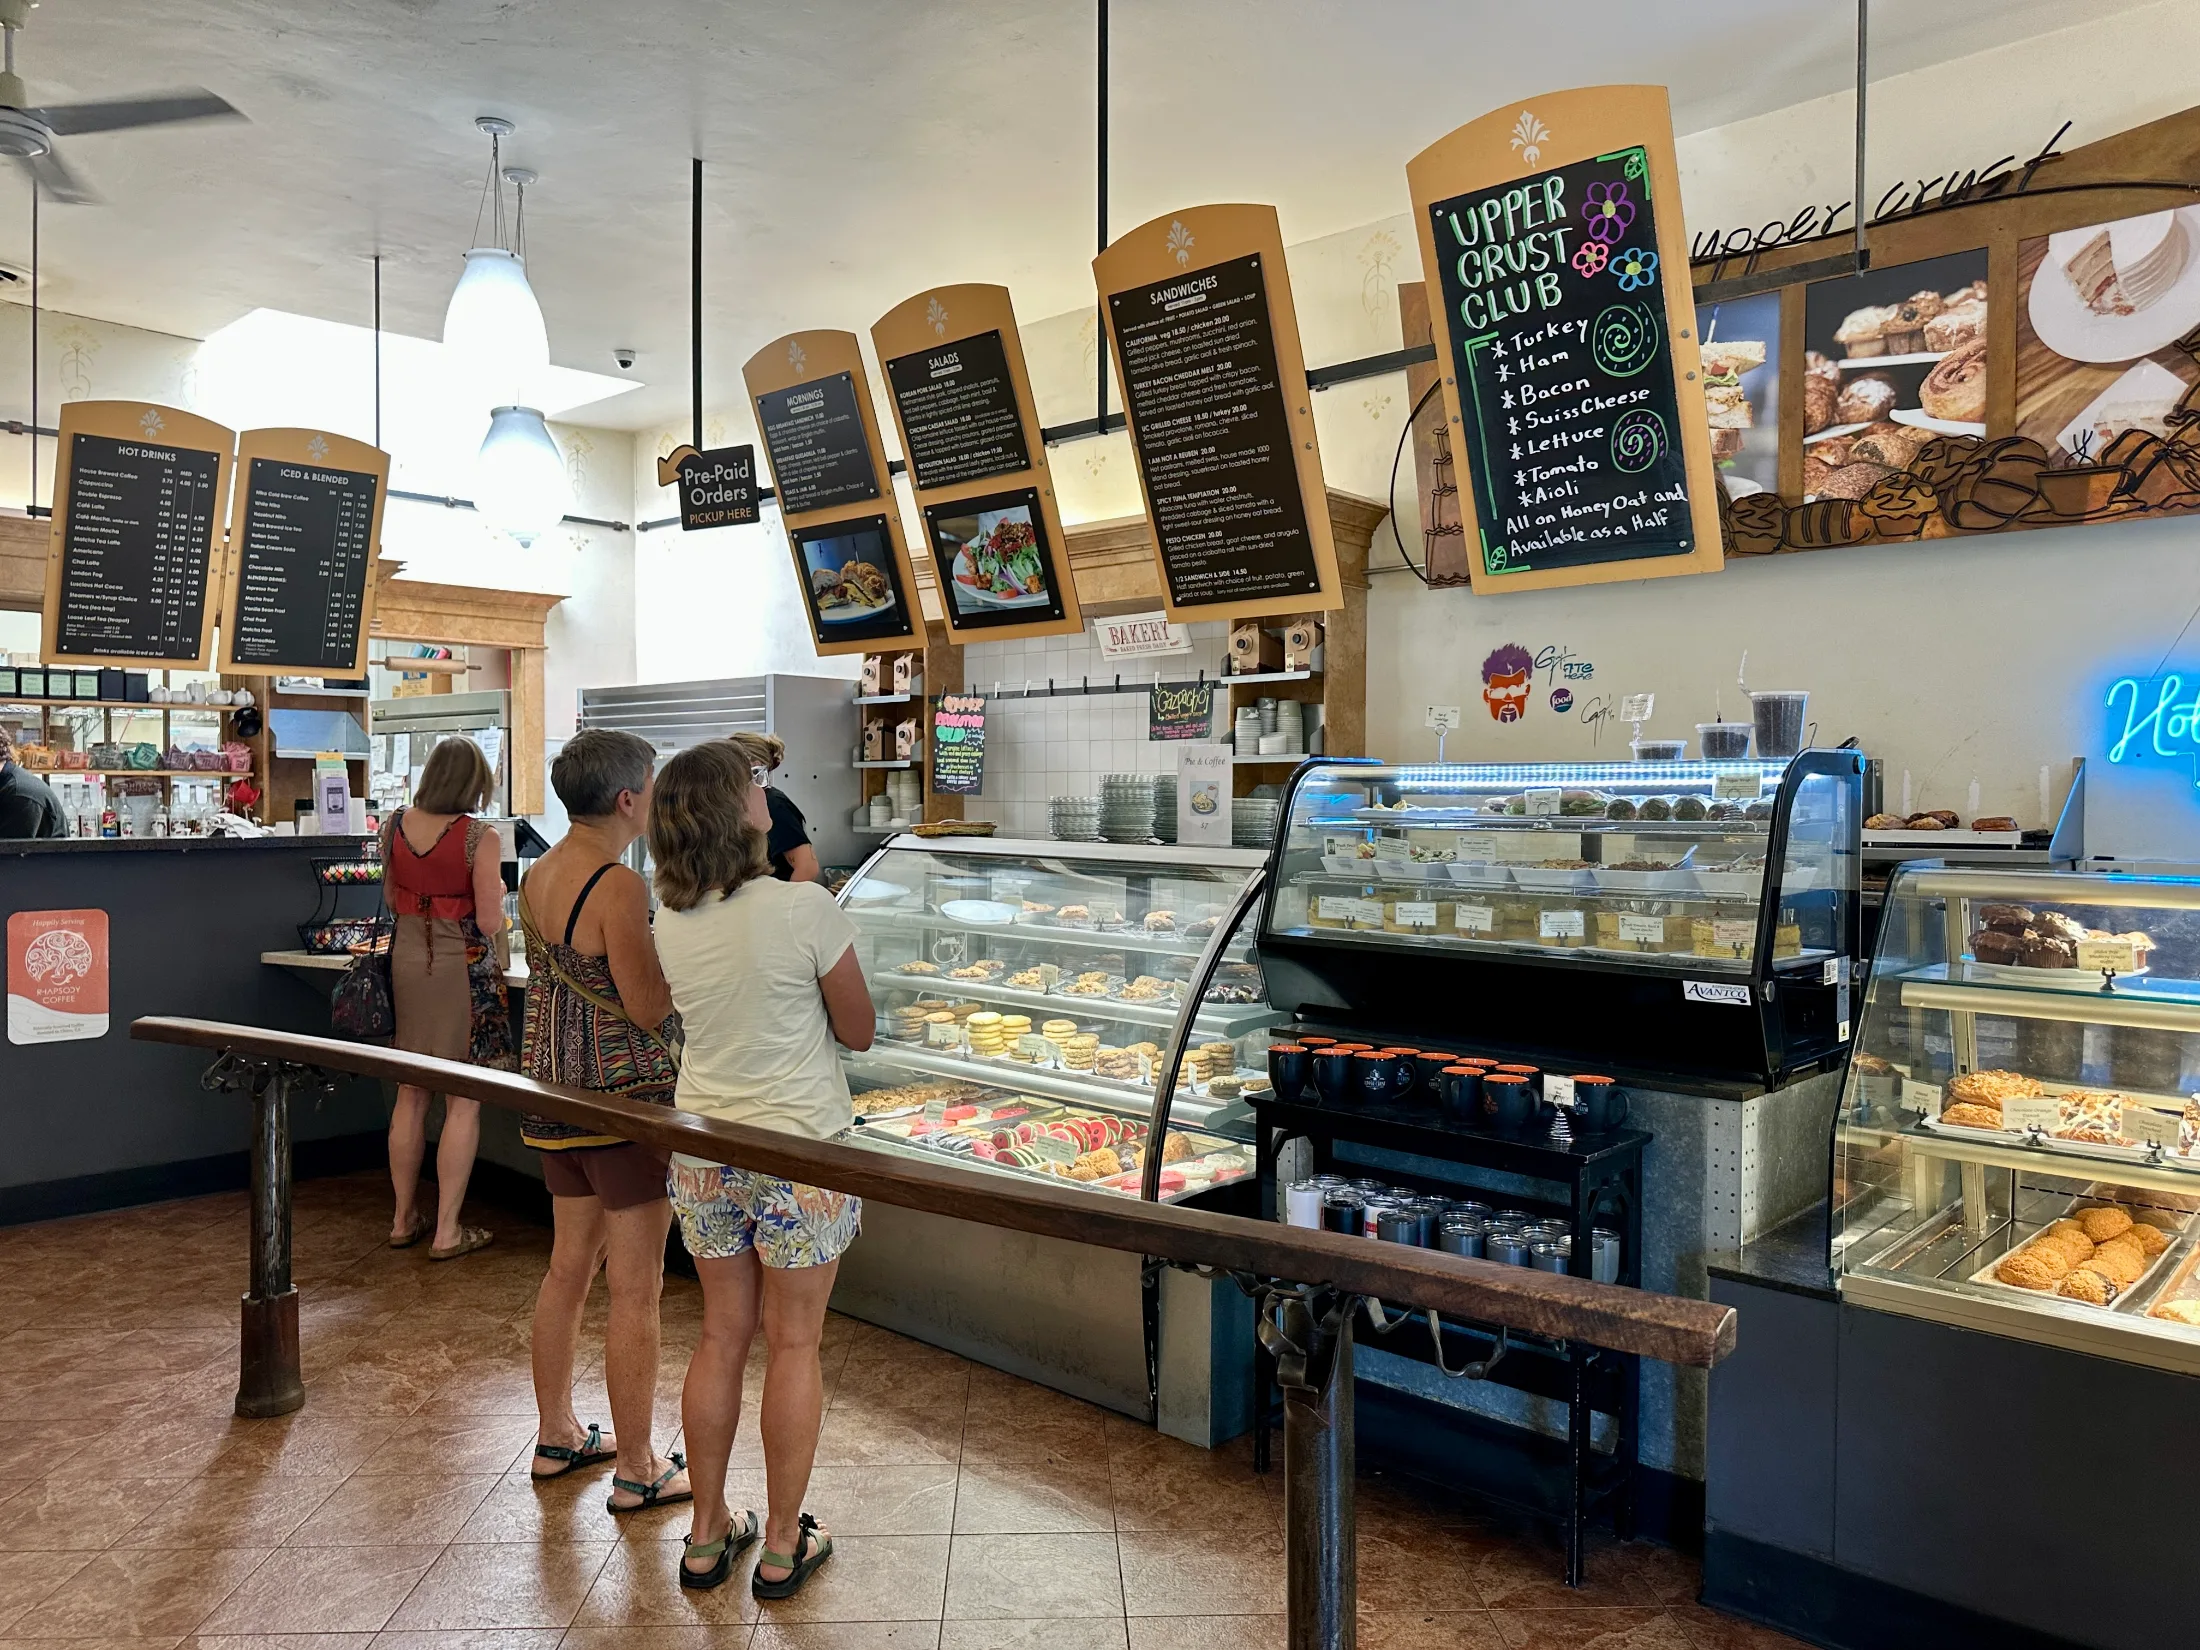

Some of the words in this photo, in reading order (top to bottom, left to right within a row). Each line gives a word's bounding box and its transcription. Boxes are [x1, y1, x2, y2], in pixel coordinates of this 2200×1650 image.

[1448, 175, 1568, 246] UPPER
[1691, 201, 1851, 281] upper
[1874, 120, 2072, 220] crust
[1457, 227, 1573, 290] CRUST
[1150, 275, 1217, 304] SANDWICHES
[1459, 272, 1564, 331] CLUB
[1125, 334, 1158, 347] CALIFORNIA
[1159, 331, 1171, 340] veg
[1190, 320, 1213, 331] chicken
[1213, 314, 1229, 325] 20.00
[1510, 318, 1589, 352] Turkey
[928, 352, 959, 369] SALADS
[1520, 350, 1569, 373] Ham
[1132, 380, 1151, 390] TURKEY
[1152, 375, 1173, 385] BACON
[1173, 368, 1200, 380] CHEDDAR
[1200, 365, 1214, 374] MELT
[1216, 361, 1232, 371] 20.00
[786, 388, 823, 406] MORNINGS
[1521, 377, 1591, 406] Bacon
[1581, 388, 1651, 414] Cheese
[1150, 420, 1171, 430] GRILLED
[1171, 415, 1192, 425] CHEESE
[1212, 408, 1230, 418] turkey
[1231, 403, 1247, 413] 20.00
[1528, 426, 1604, 455] Lettuce
[118, 446, 139, 456] HOT
[141, 449, 176, 461] DRINKS
[1151, 456, 1161, 464] AM
[1160, 454, 1172, 462] NOT
[1178, 449, 1198, 458] REUBEN
[1200, 446, 1215, 455] 20.00
[97, 469, 118, 477] Brewed
[280, 468, 301, 478] ICED
[303, 471, 309, 480] &
[312, 472, 348, 484] BLENDED
[684, 459, 749, 486] Pre-Paid
[1527, 455, 1599, 483] Tomato
[78, 478, 113, 488] Cappuccino
[1535, 480, 1580, 504] Aioli
[98, 492, 122, 500] Espresso
[691, 484, 748, 506] Orders
[1156, 496, 1171, 505] SPICY
[1187, 488, 1219, 499] TEMPTATION
[1221, 485, 1236, 494] 20.00
[690, 511, 724, 524] PICKUP
[727, 507, 752, 520] HERE
[1506, 515, 1529, 535] All
[1535, 513, 1556, 525] on
[1561, 501, 1610, 519] Honey
[1613, 490, 1648, 510] Oat
[1654, 482, 1688, 502] and
[74, 524, 99, 532] Mexican
[1165, 536, 1181, 544] PESTO
[1181, 533, 1206, 542] CHICKEN
[1207, 530, 1222, 538] 20.00
[1511, 525, 1588, 557] Available
[1590, 527, 1611, 539] as
[1614, 525, 1628, 536] a
[1632, 508, 1669, 532] Half
[72, 547, 103, 555] Americano
[1184, 572, 1213, 581] SANDWICH
[1108, 621, 1170, 646] BAKERY
[1153, 641, 1167, 650] DAILY
[1158, 688, 1206, 713] Gazpacho
[1552, 692, 1572, 708] food
[1185, 758, 1195, 766] Pie
[1204, 756, 1226, 768] Coffee
[1201, 822, 1209, 830] $7
[33, 919, 59, 927] Happily
[36, 986, 81, 996] RHAPSODY
[43, 995, 75, 1004] COFFEE
